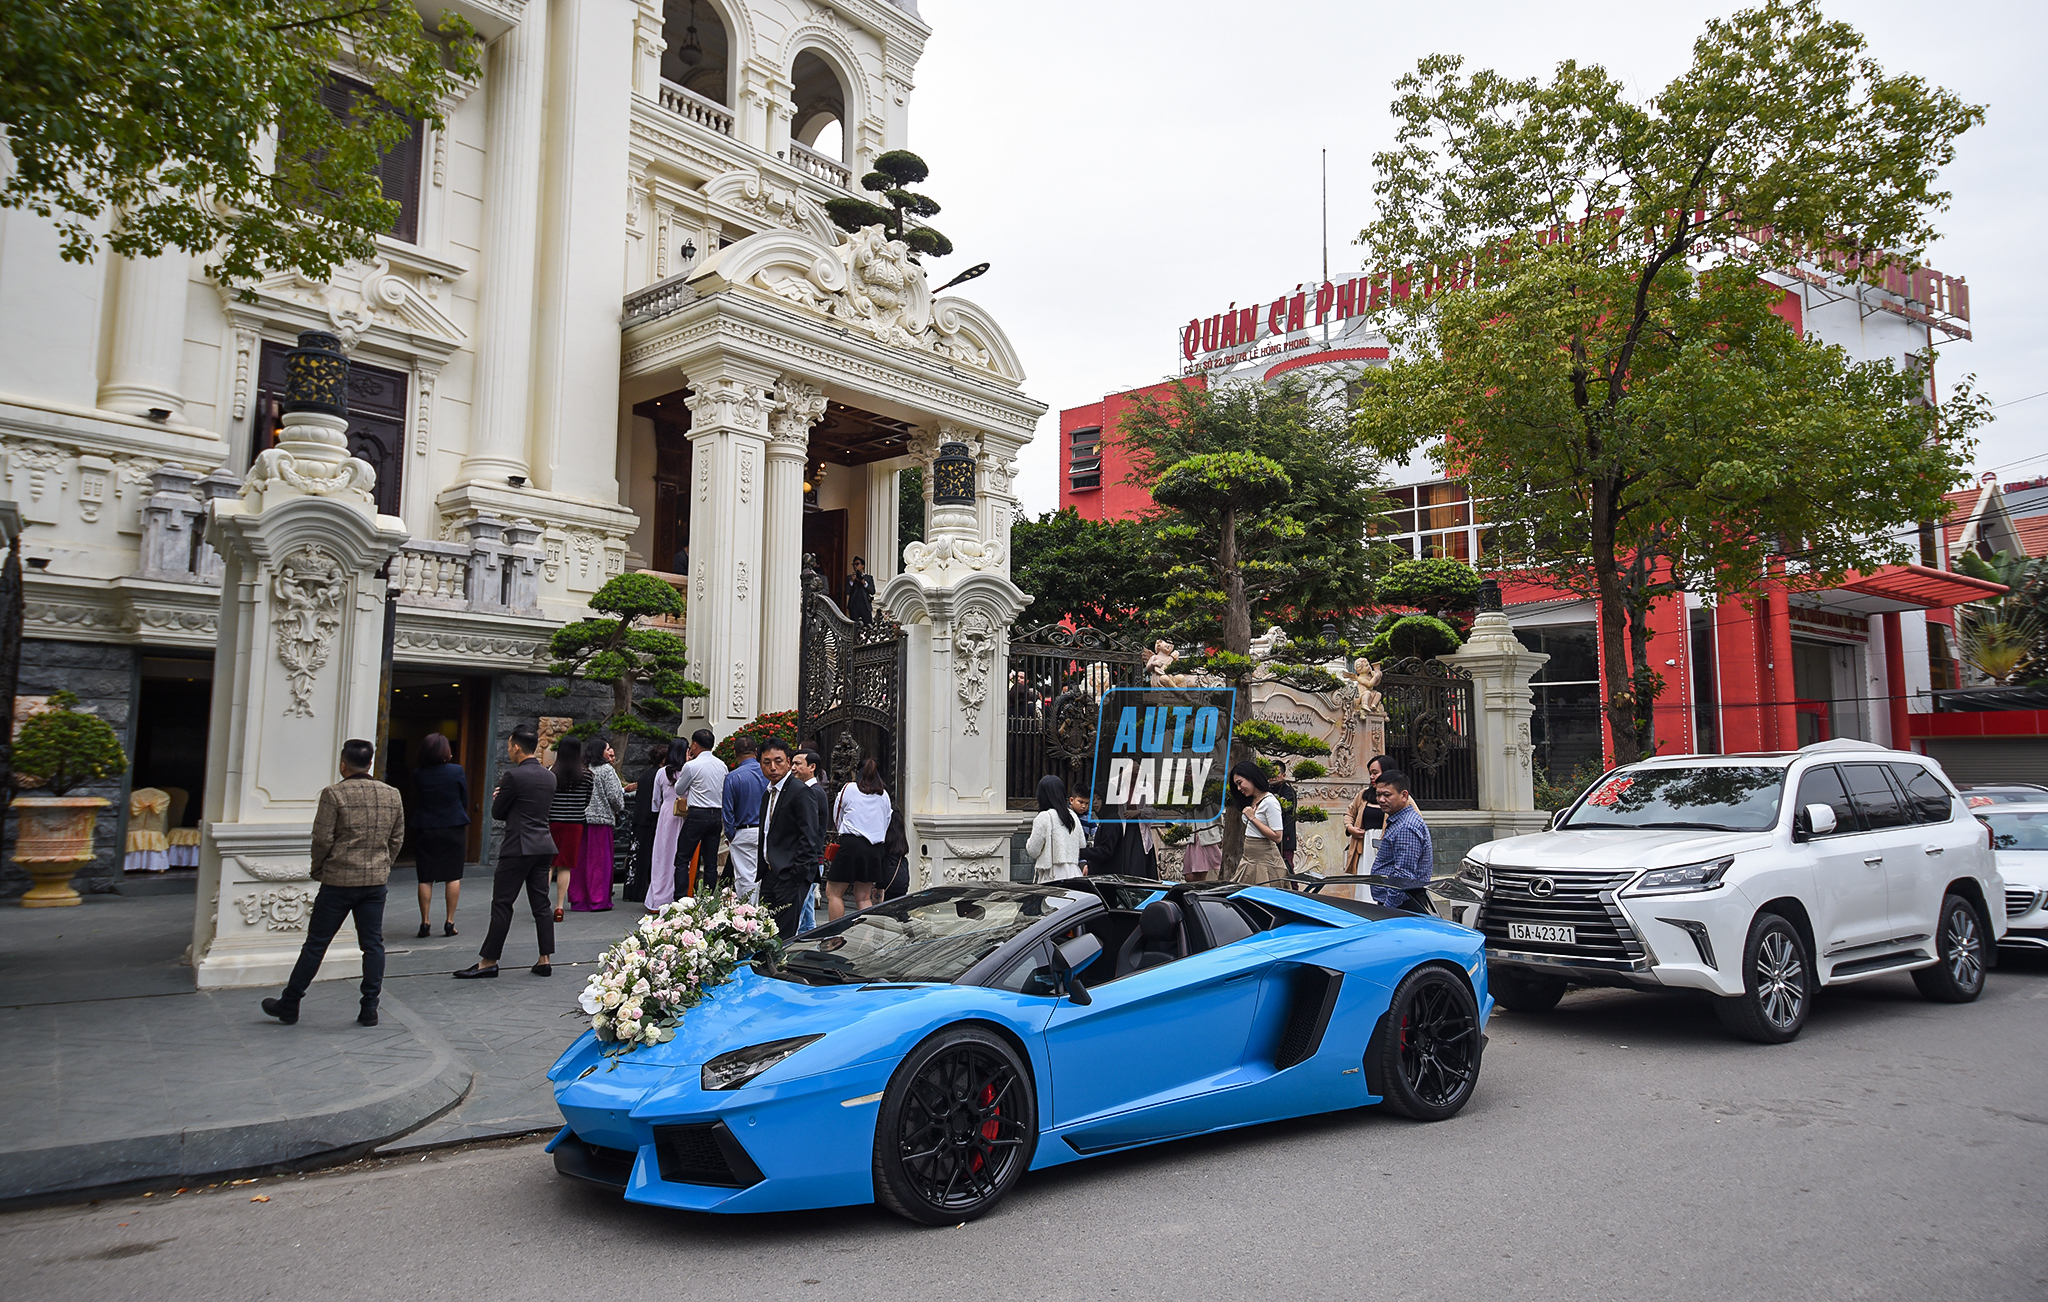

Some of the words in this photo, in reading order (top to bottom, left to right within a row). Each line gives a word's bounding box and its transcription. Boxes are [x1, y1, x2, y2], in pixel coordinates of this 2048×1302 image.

[1184, 302, 1259, 360] QUÁN
[1268, 284, 1306, 336] CÁ
[1283, 337, 1310, 351] PHONG
[1512, 924, 1572, 942] 15A-423.21
